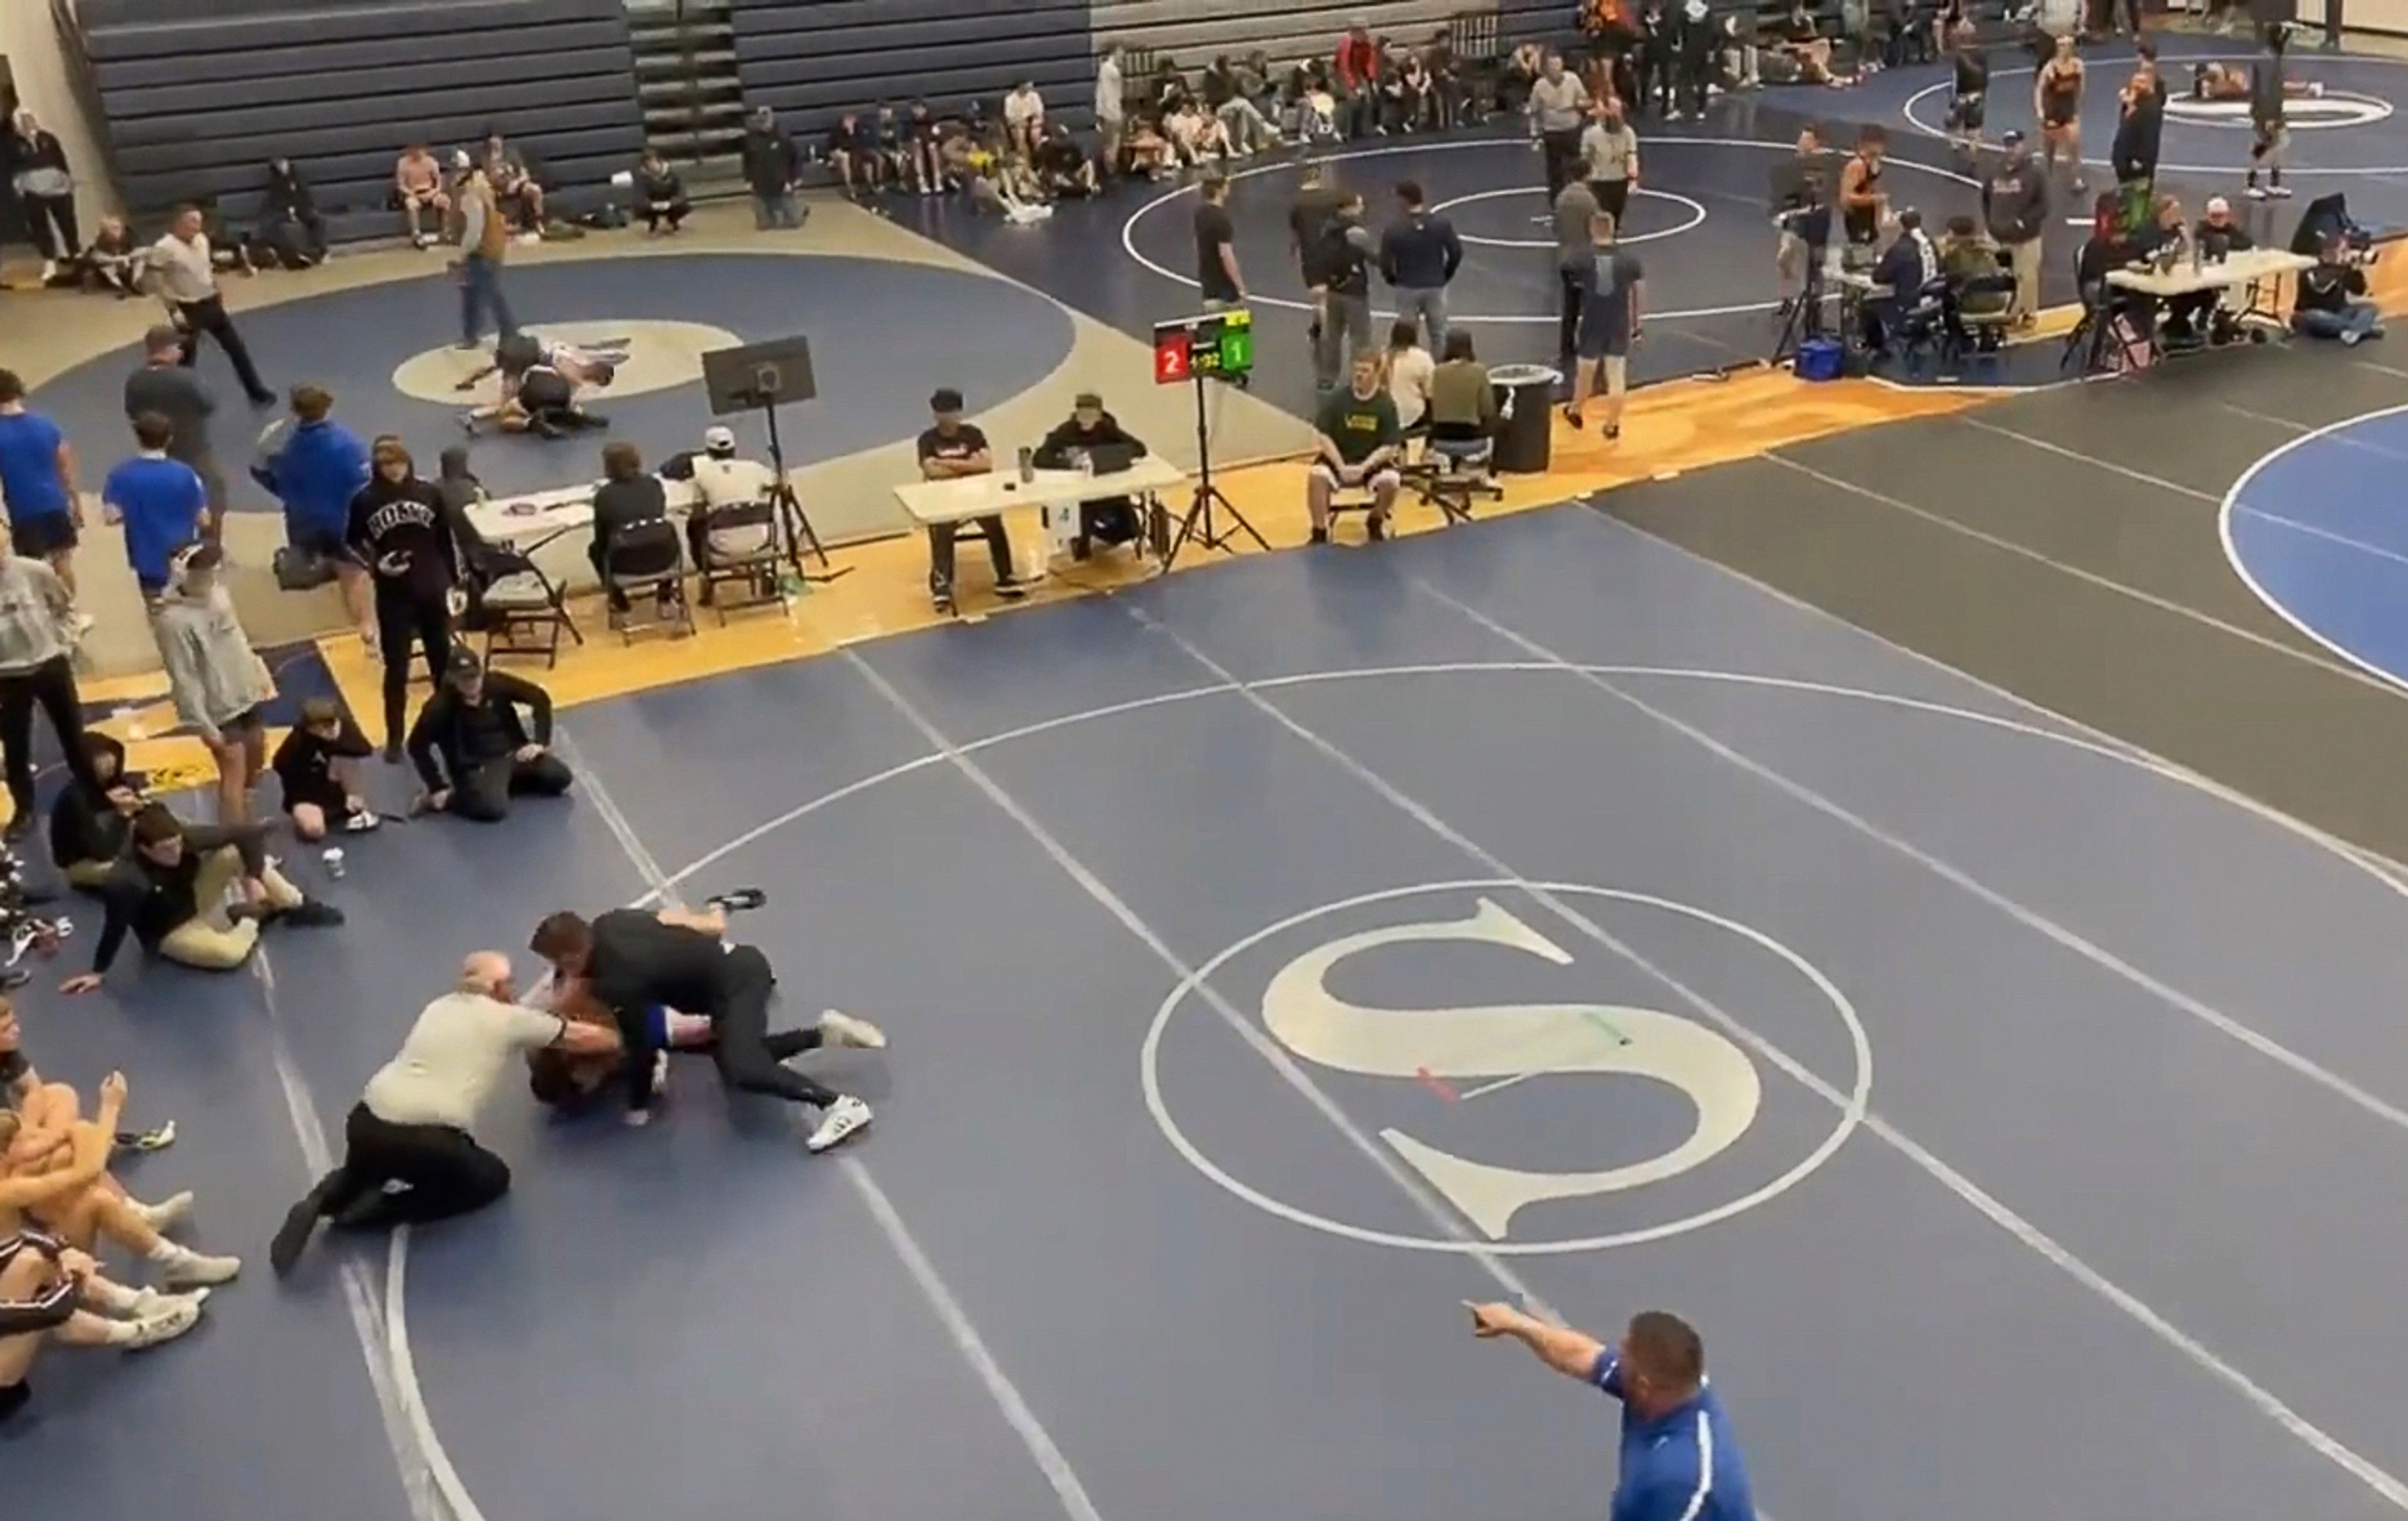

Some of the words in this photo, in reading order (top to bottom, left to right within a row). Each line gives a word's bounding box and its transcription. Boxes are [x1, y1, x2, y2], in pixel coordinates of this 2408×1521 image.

[1164, 350, 1180, 374] 2
[1230, 341, 1242, 362] 1
[1262, 897, 1760, 1240] S
